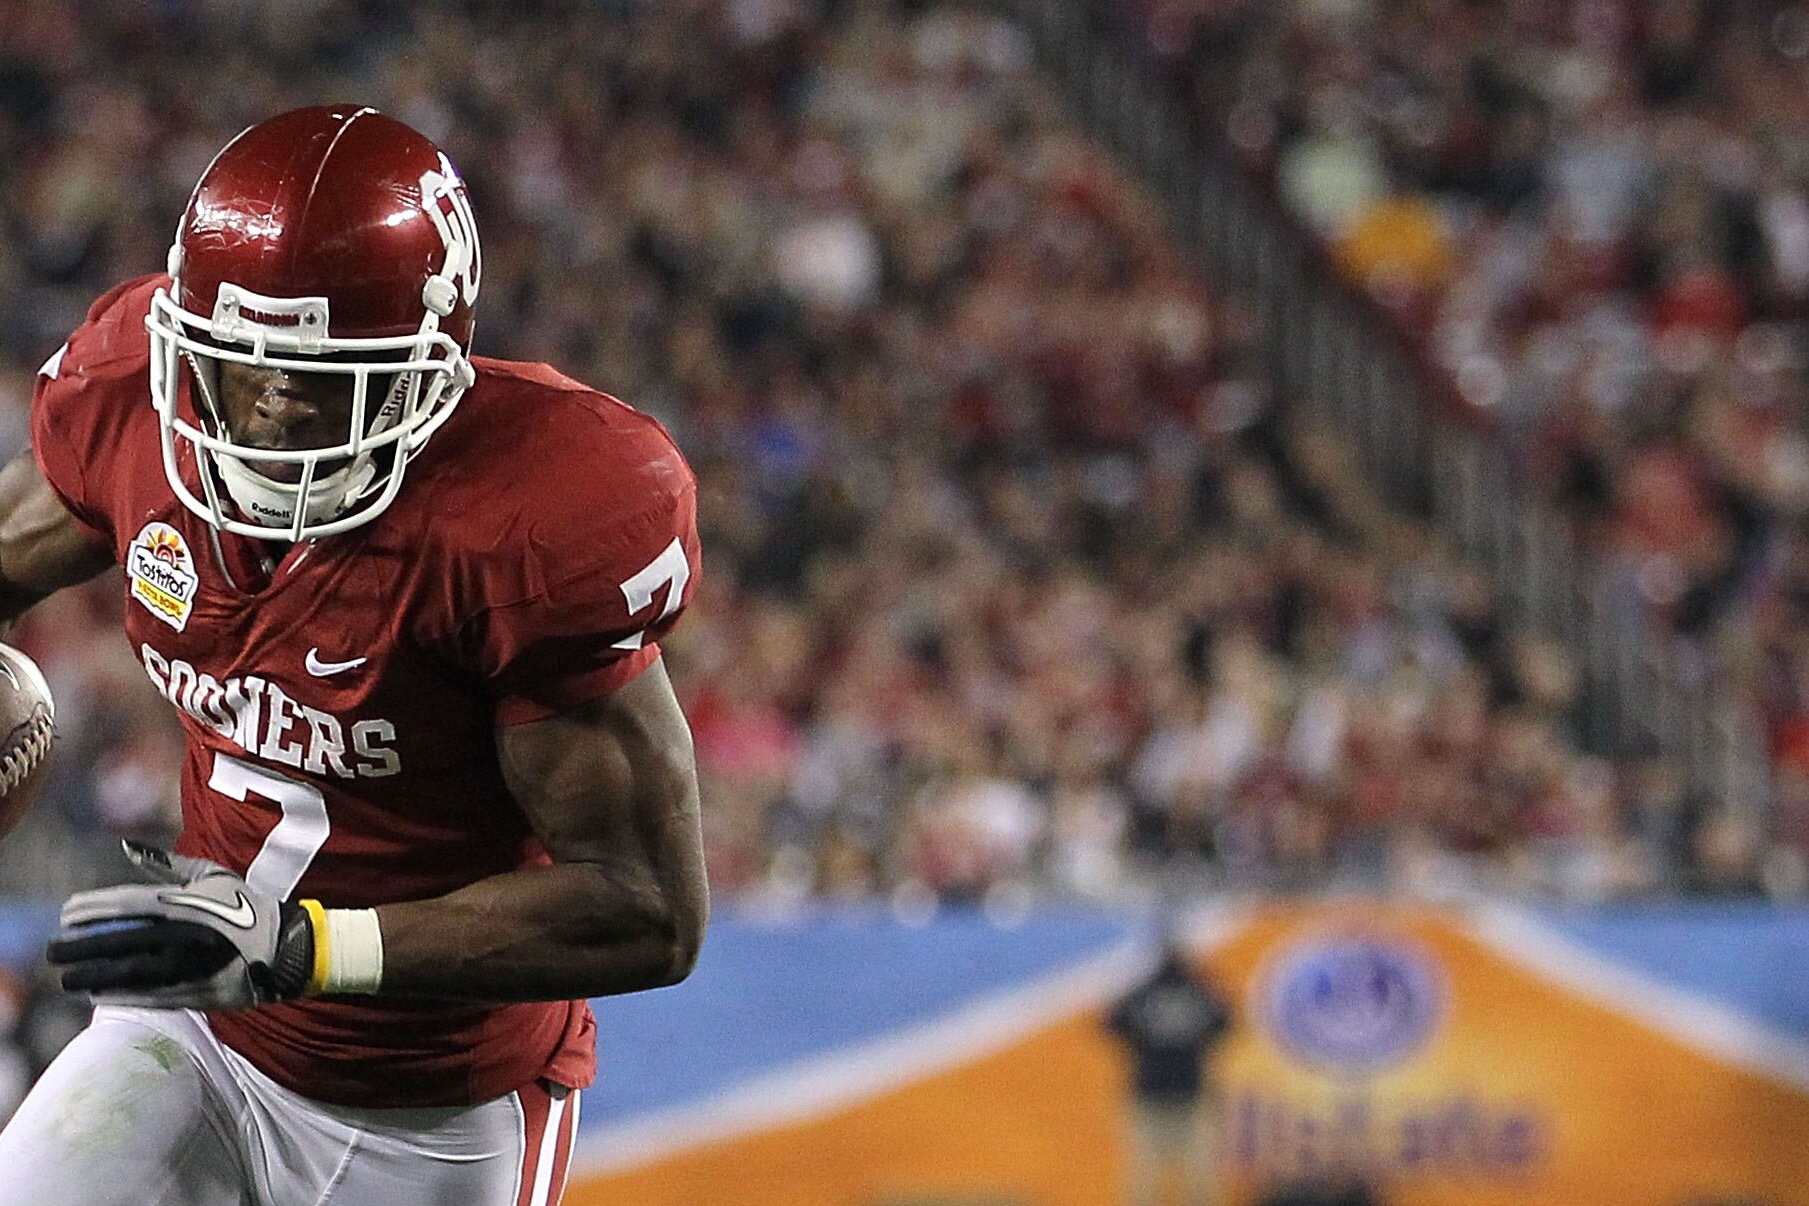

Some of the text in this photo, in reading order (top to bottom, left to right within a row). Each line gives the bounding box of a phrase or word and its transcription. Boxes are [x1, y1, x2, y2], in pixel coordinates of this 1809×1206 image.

[137, 554, 188, 597] Tostitos
[610, 535, 690, 650] 7
[141, 643, 401, 779] SOONERS
[208, 751, 330, 903] 7
